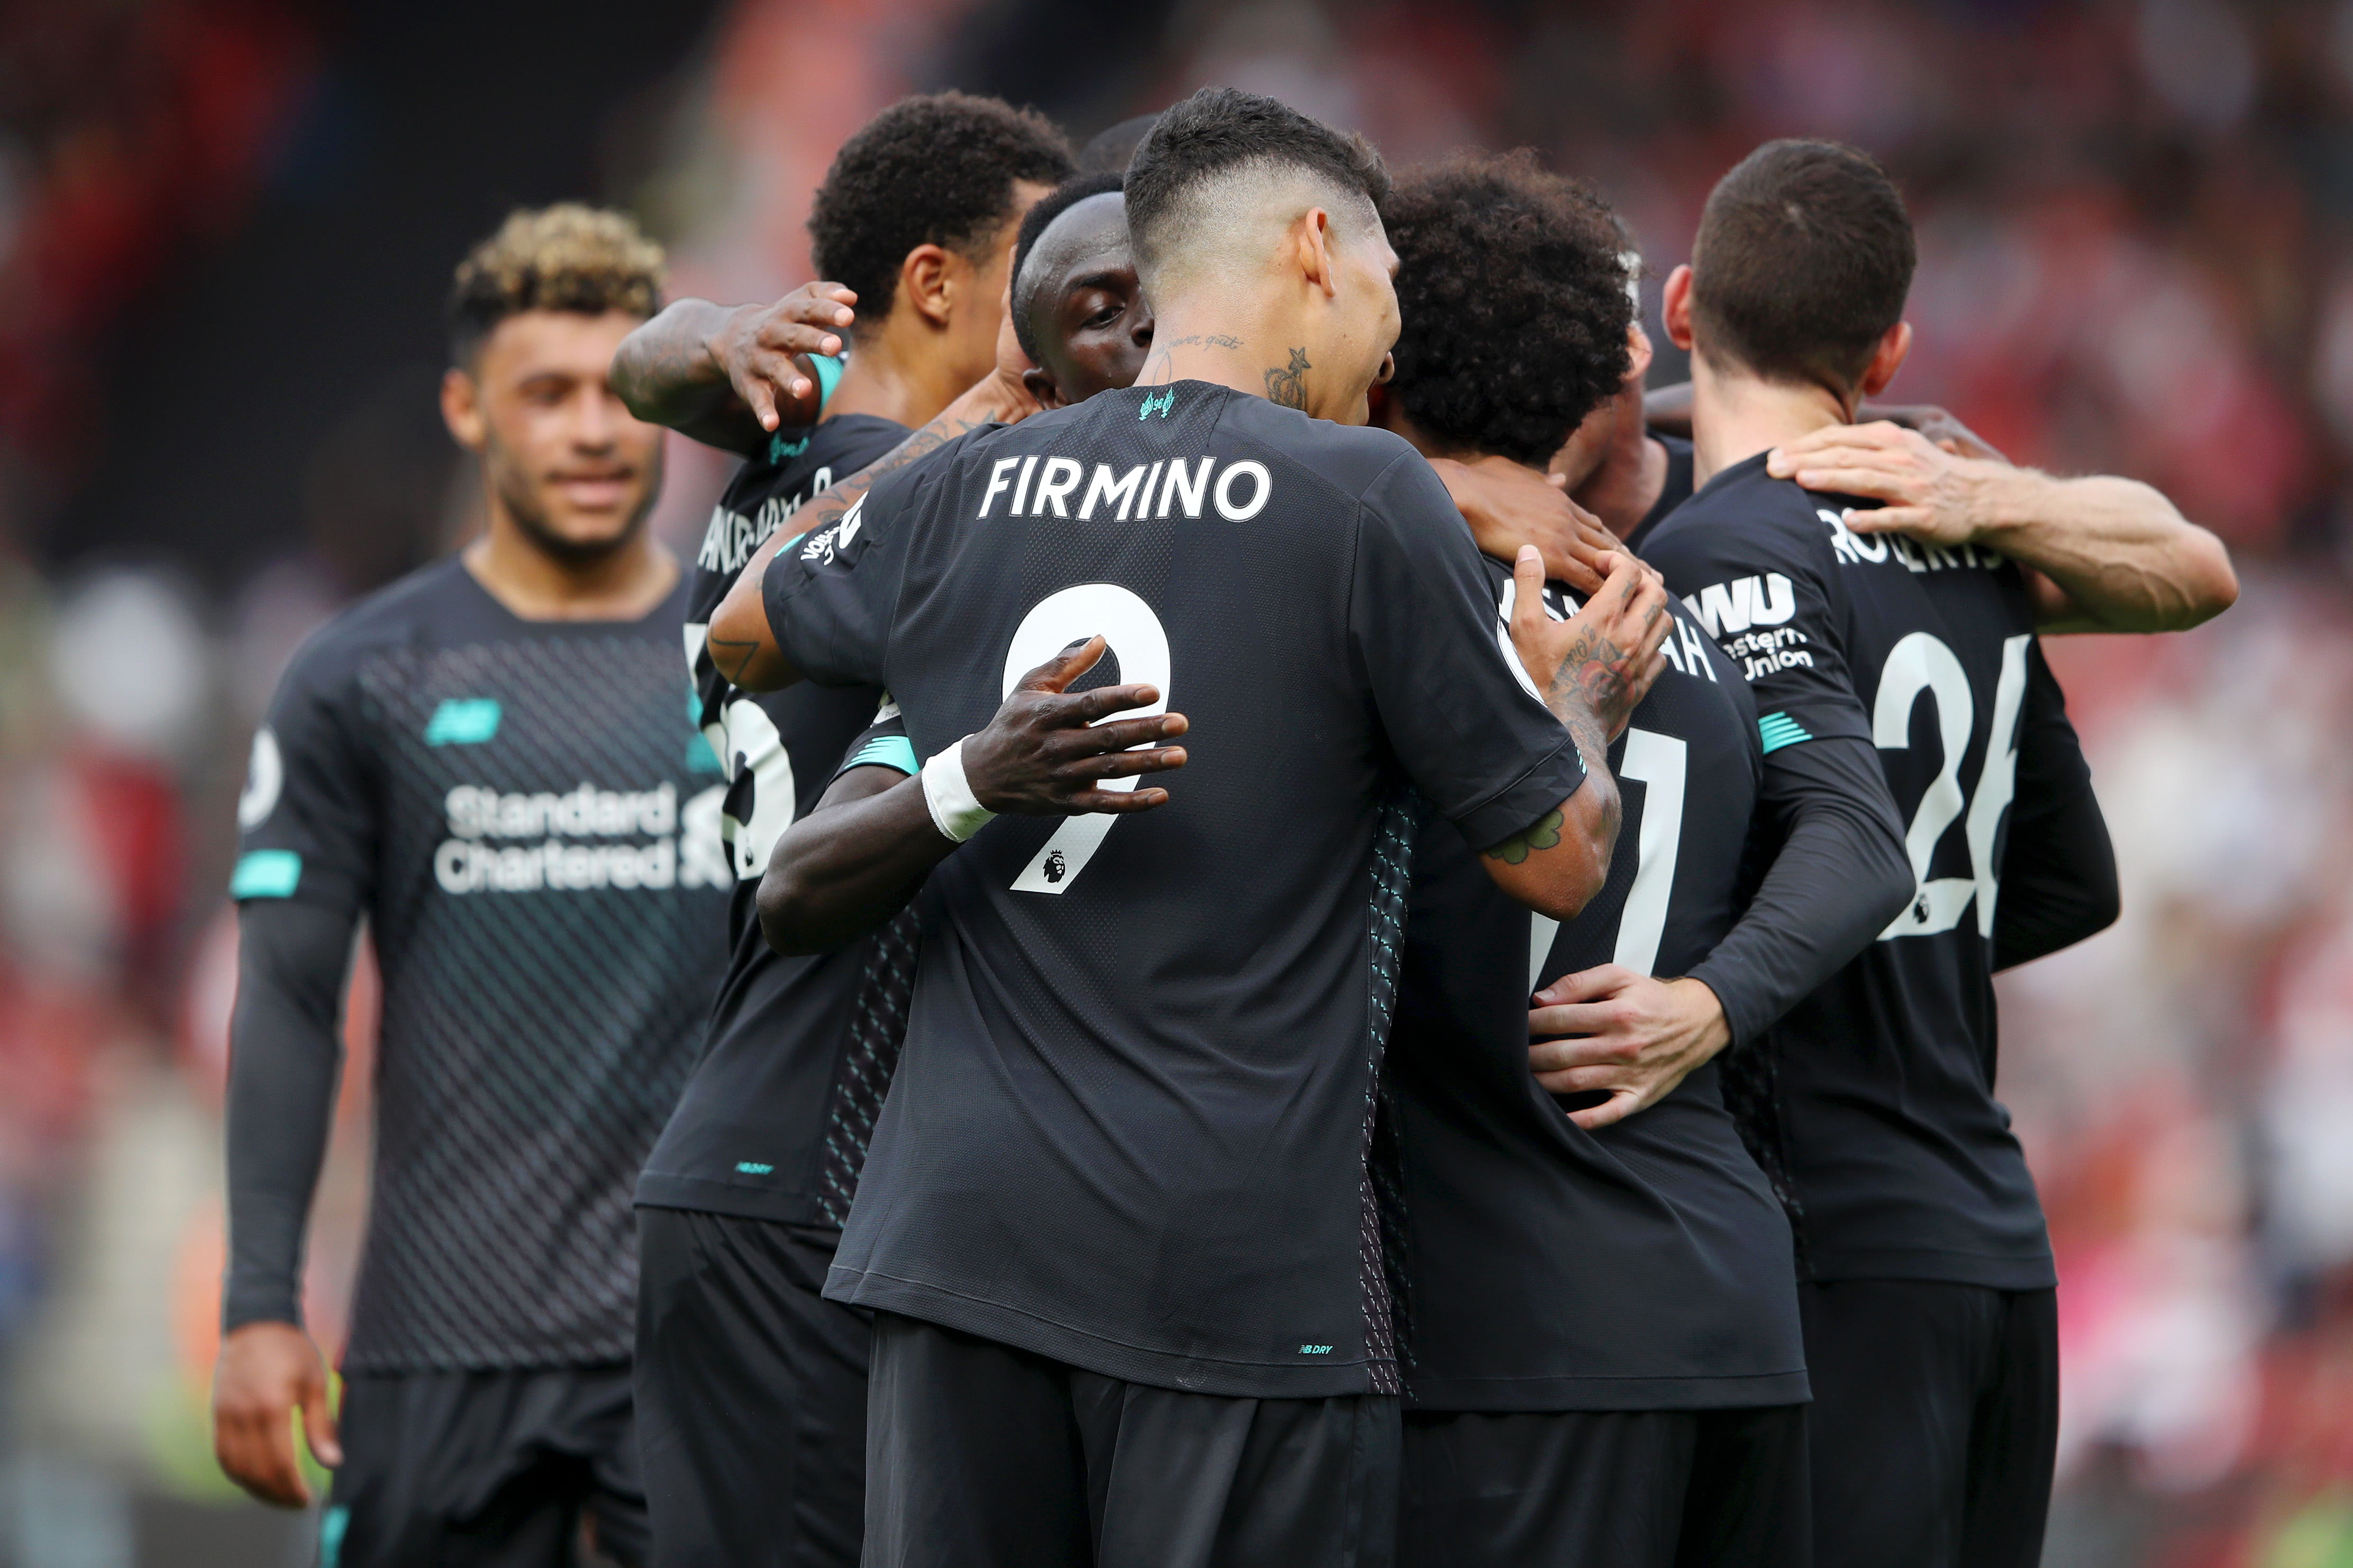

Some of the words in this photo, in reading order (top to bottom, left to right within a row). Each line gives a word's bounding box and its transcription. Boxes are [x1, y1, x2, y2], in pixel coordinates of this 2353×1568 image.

[977, 455, 1272, 522] FIRMINO
[1001, 581, 1171, 894] 9
[445, 781, 678, 839] Standard
[433, 837, 678, 895] Chartered
